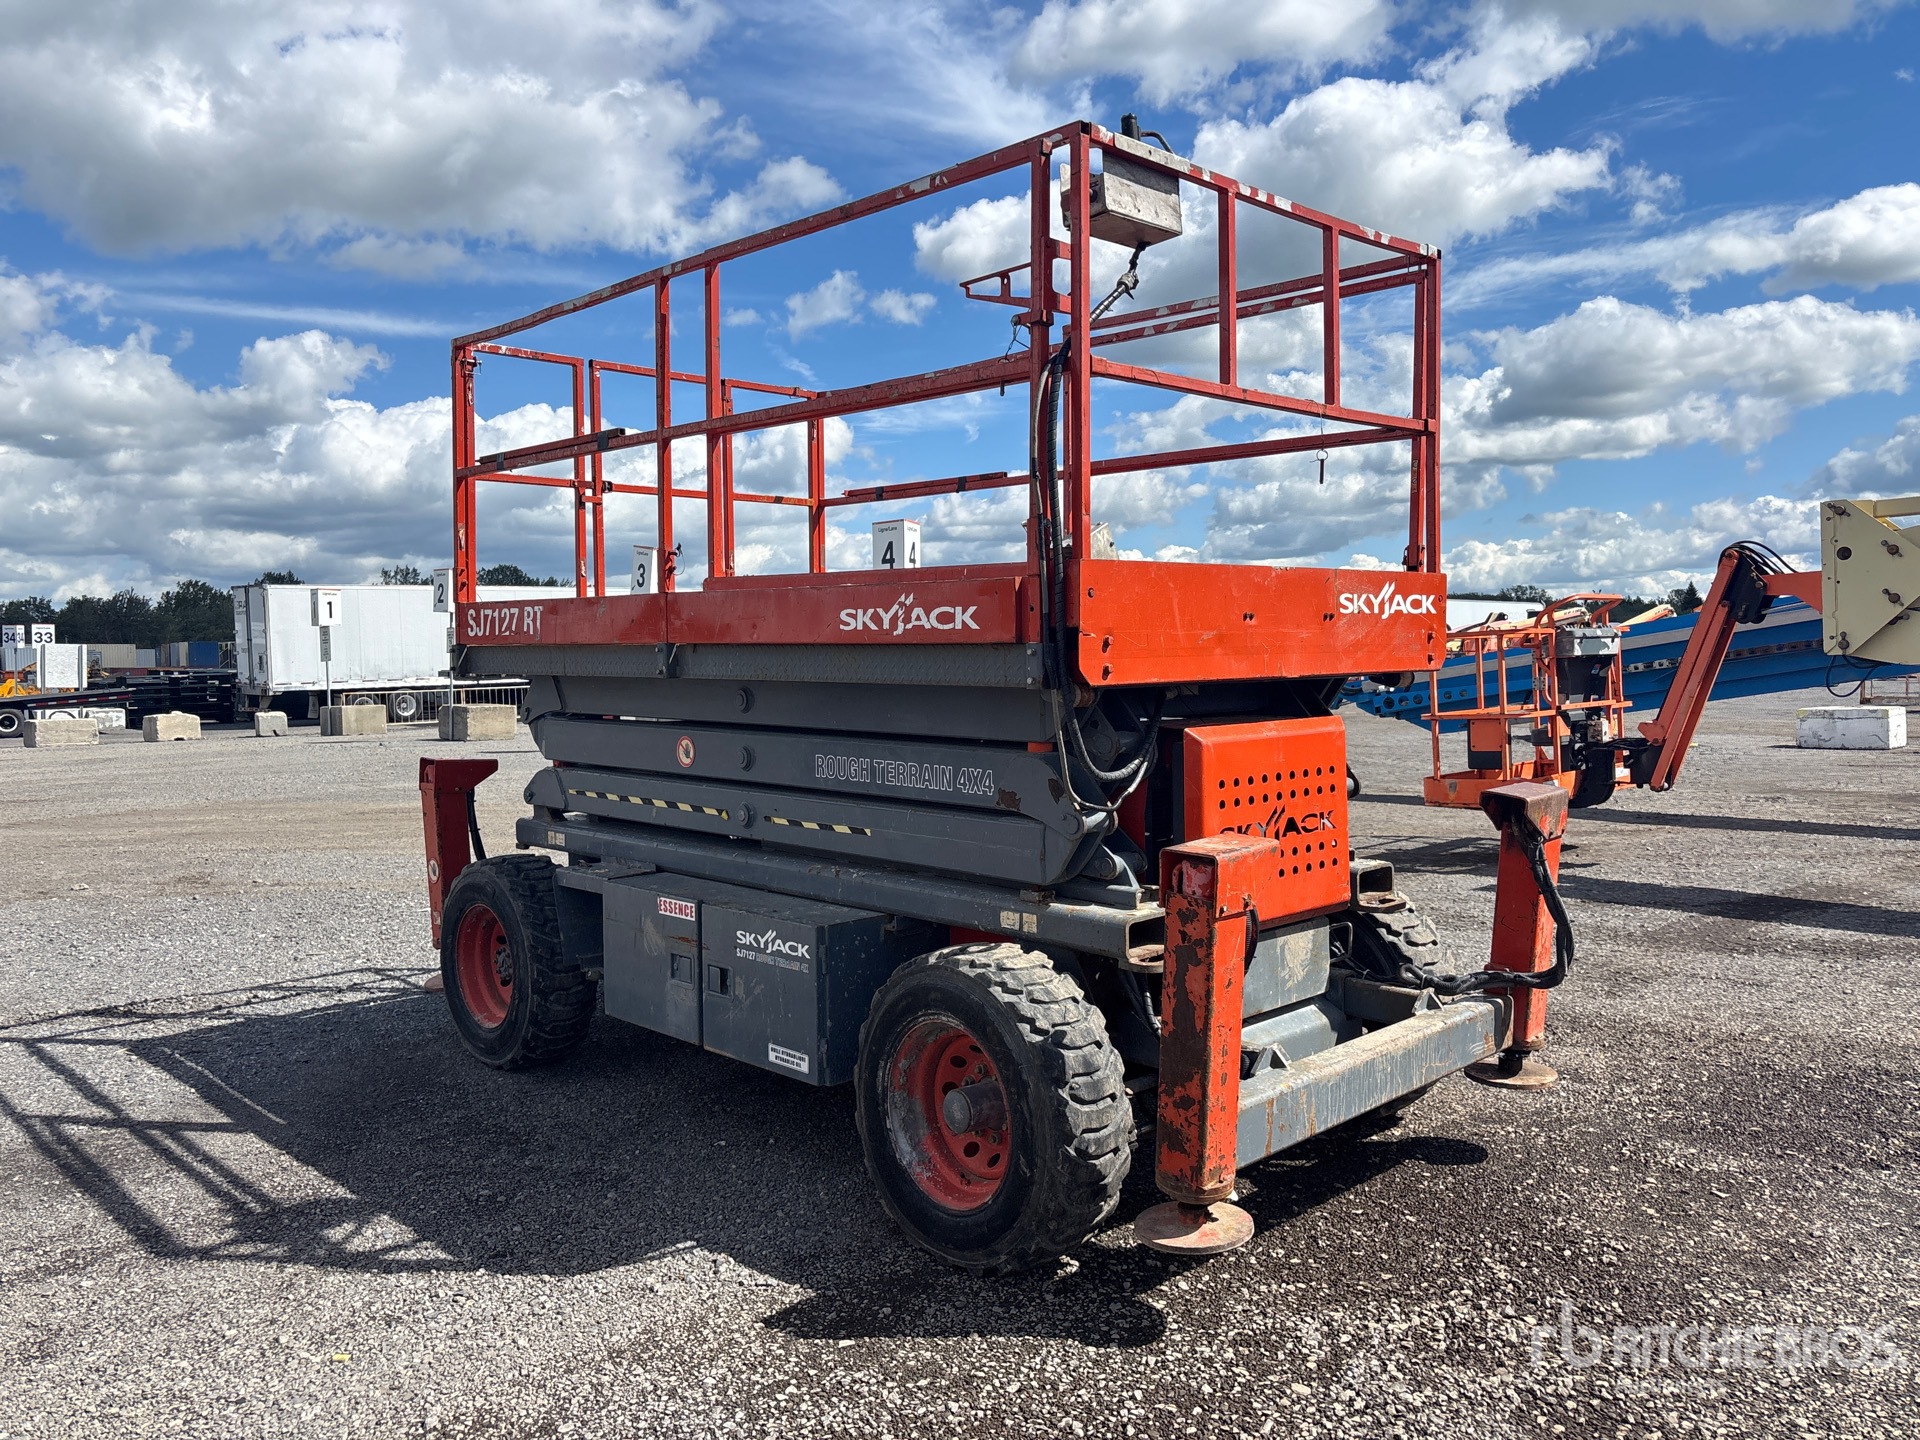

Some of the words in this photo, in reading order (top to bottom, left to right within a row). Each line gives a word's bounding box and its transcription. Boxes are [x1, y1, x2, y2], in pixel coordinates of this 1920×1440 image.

[881, 540, 895, 570] 4
[908, 541, 916, 568] 4
[636, 563, 646, 588] 3
[437, 583, 445, 604] 2
[1339, 580, 1437, 620] SKYJACK
[326, 601, 333, 619] 1
[467, 607, 519, 637] SJ7127
[523, 605, 544, 640] RT
[839, 592, 981, 636] SKYJACK
[3, 632, 16, 644] 34
[33, 631, 54, 644] 33
[815, 754, 871, 783] ROUGH
[873, 759, 953, 791] TERRAIN
[956, 767, 995, 796] 4X4
[658, 898, 694, 919] ESSENCE
[736, 929, 811, 960] SKYJACK
[736, 947, 756, 961] SJ7127
